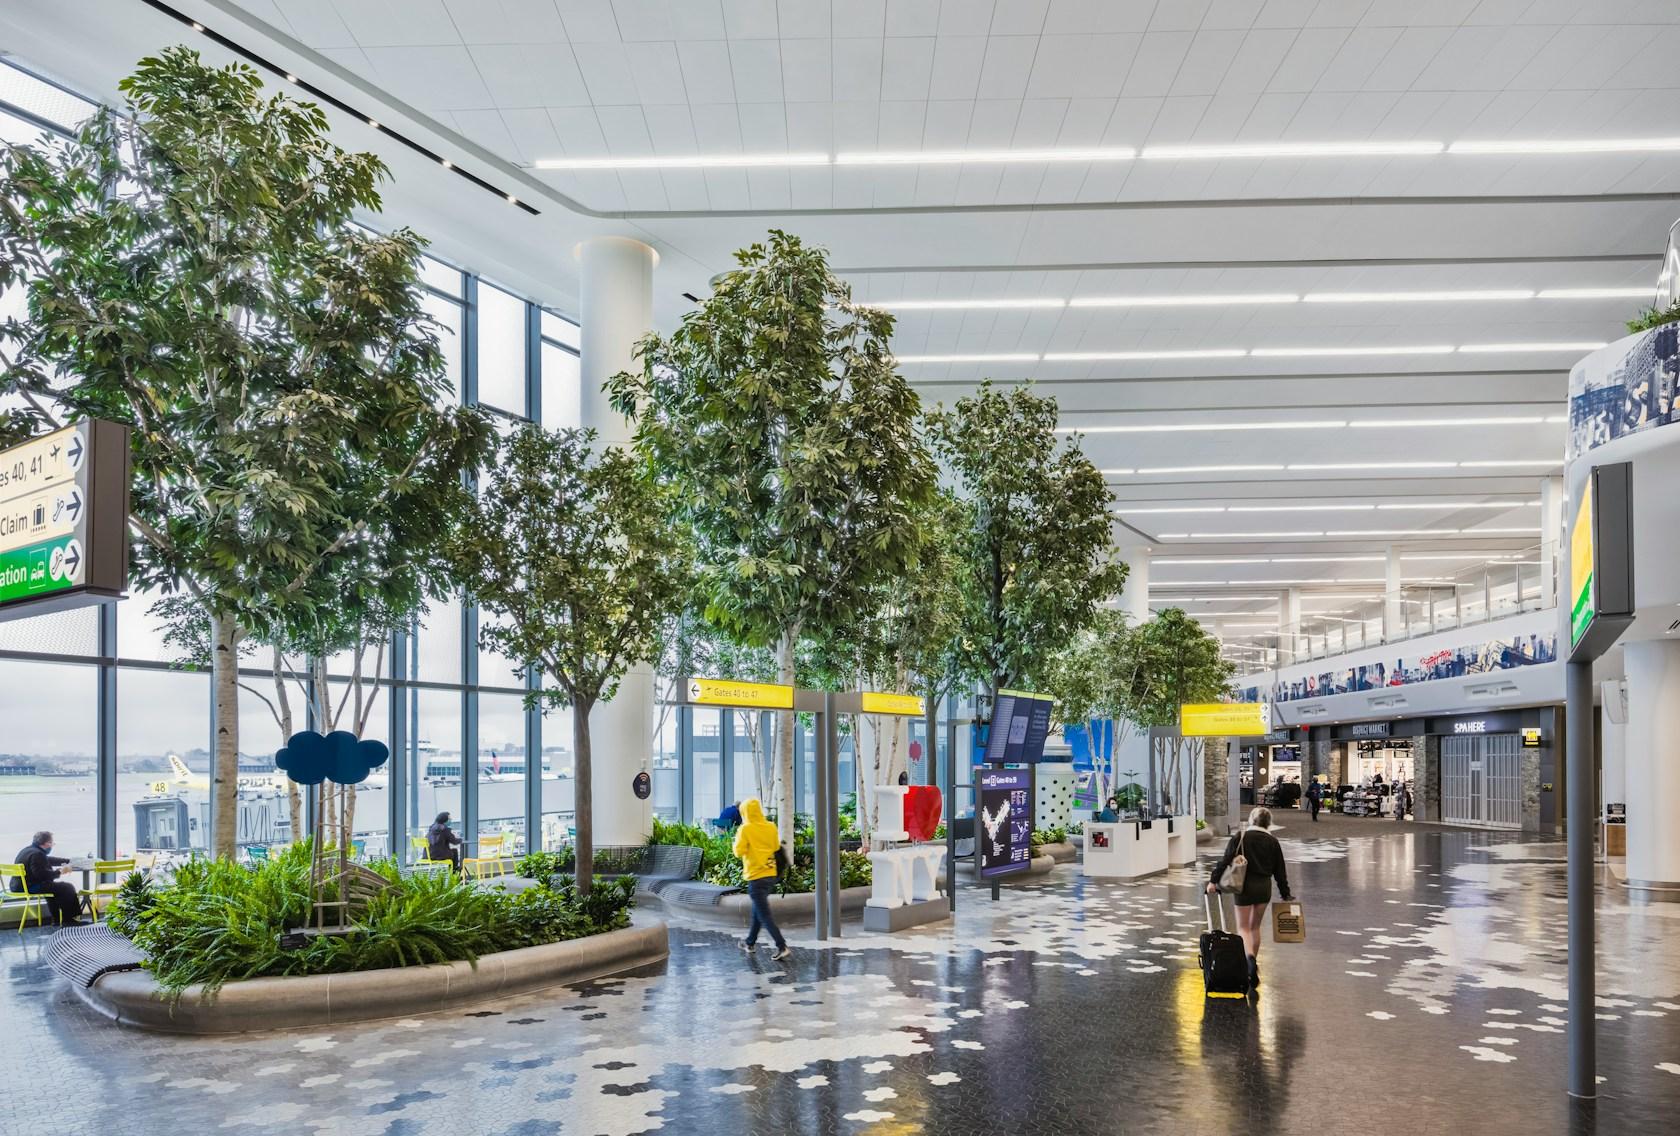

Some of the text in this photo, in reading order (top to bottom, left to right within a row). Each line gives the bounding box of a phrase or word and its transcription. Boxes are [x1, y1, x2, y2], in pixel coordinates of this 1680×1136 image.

[12, 461, 27, 482] 40,
[31, 454, 42, 475] 41
[0, 512, 28, 536] Claim
[0, 564, 28, 587] ation
[714, 687, 731, 697] Gates
[742, 690, 749, 698] to
[155, 782, 165, 792] 48
[866, 845, 948, 909] NY
